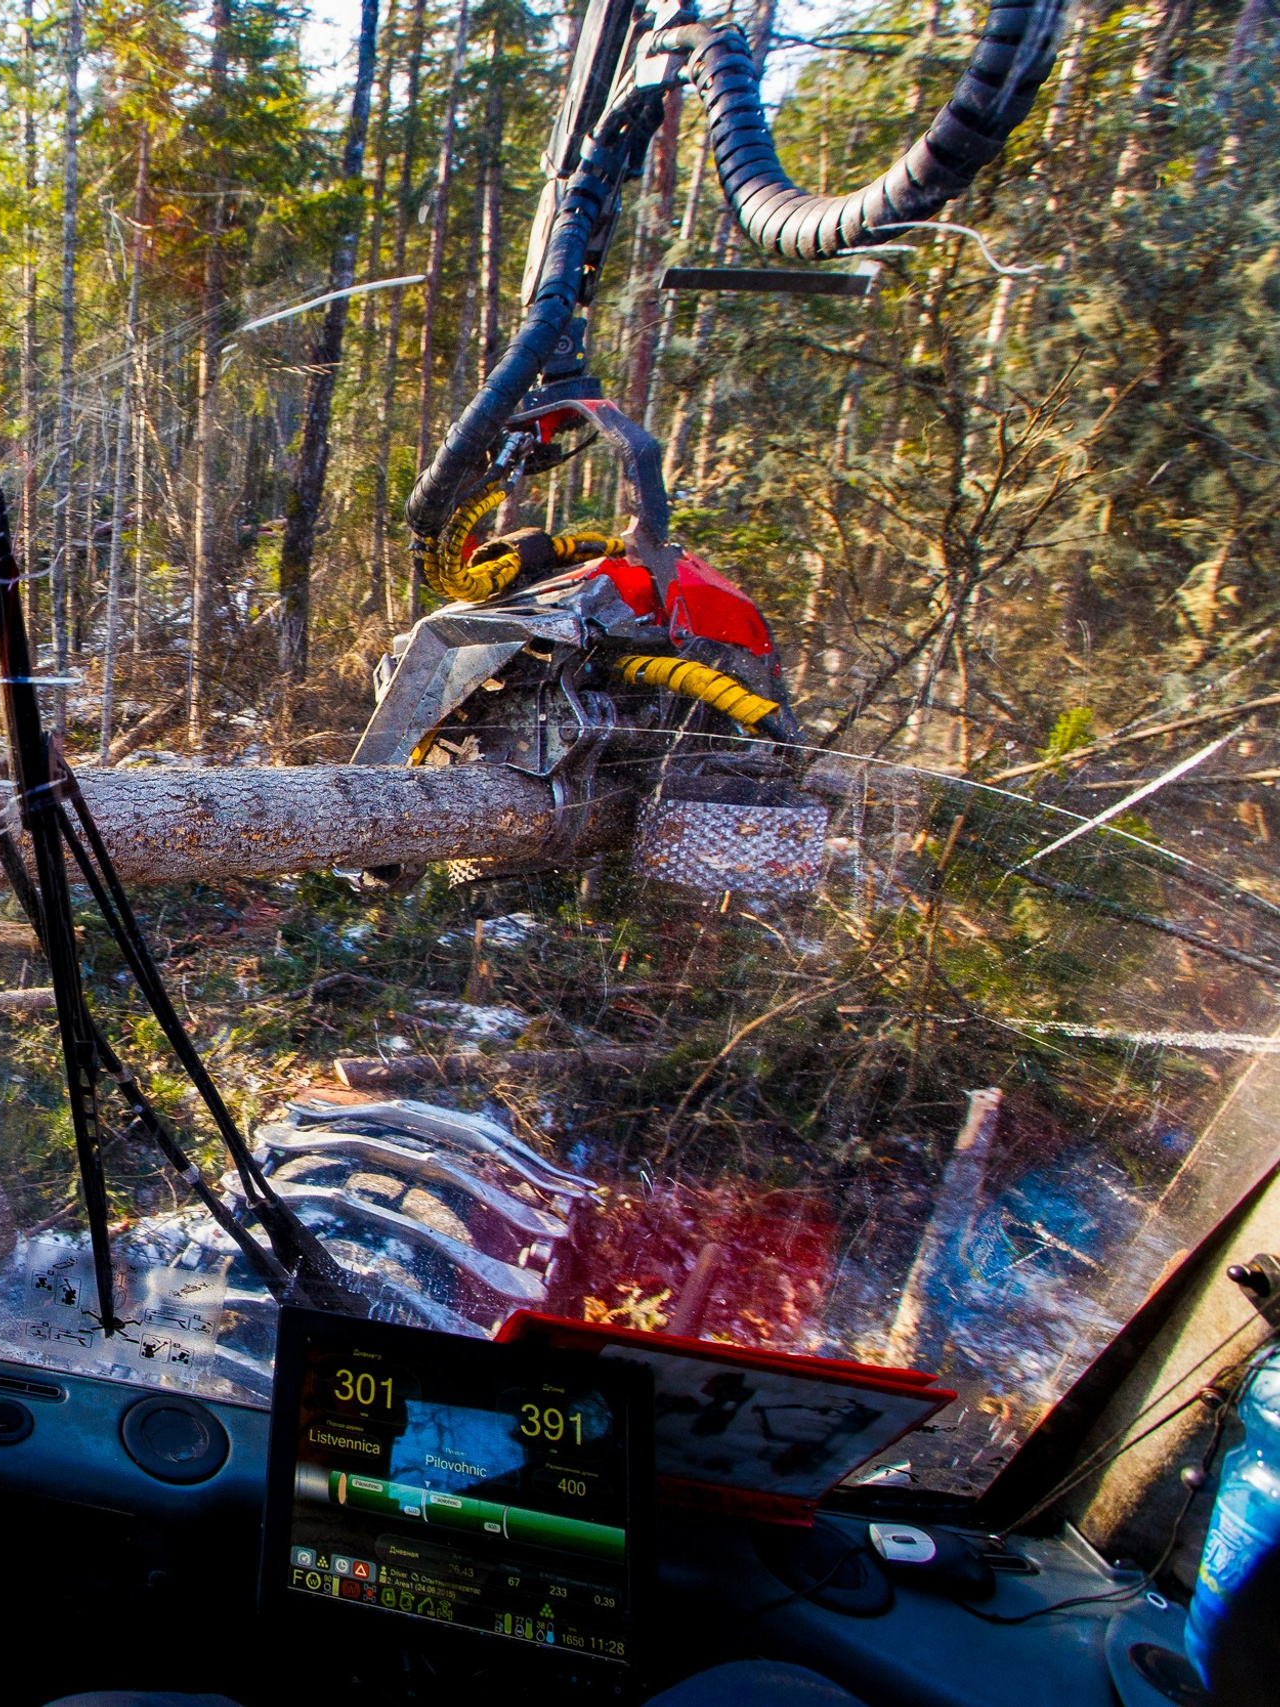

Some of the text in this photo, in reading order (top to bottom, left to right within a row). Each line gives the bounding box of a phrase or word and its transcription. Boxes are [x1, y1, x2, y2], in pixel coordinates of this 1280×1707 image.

[334, 1369, 393, 1410] 301
[520, 1403, 582, 1446] 391
[309, 1429, 381, 1455] Listvennica
[425, 1454, 487, 1478] Pilovohnic
[558, 1478, 586, 1497] 400
[389, 1545, 419, 1559] Дневная
[293, 1569, 305, 1585] F
[508, 1576, 520, 1588] 67
[549, 1585, 568, 1598] 233
[594, 1595, 616, 1608] 0.39
[561, 1634, 584, 1648] 1650
[589, 1637, 625, 1657] 11:28
